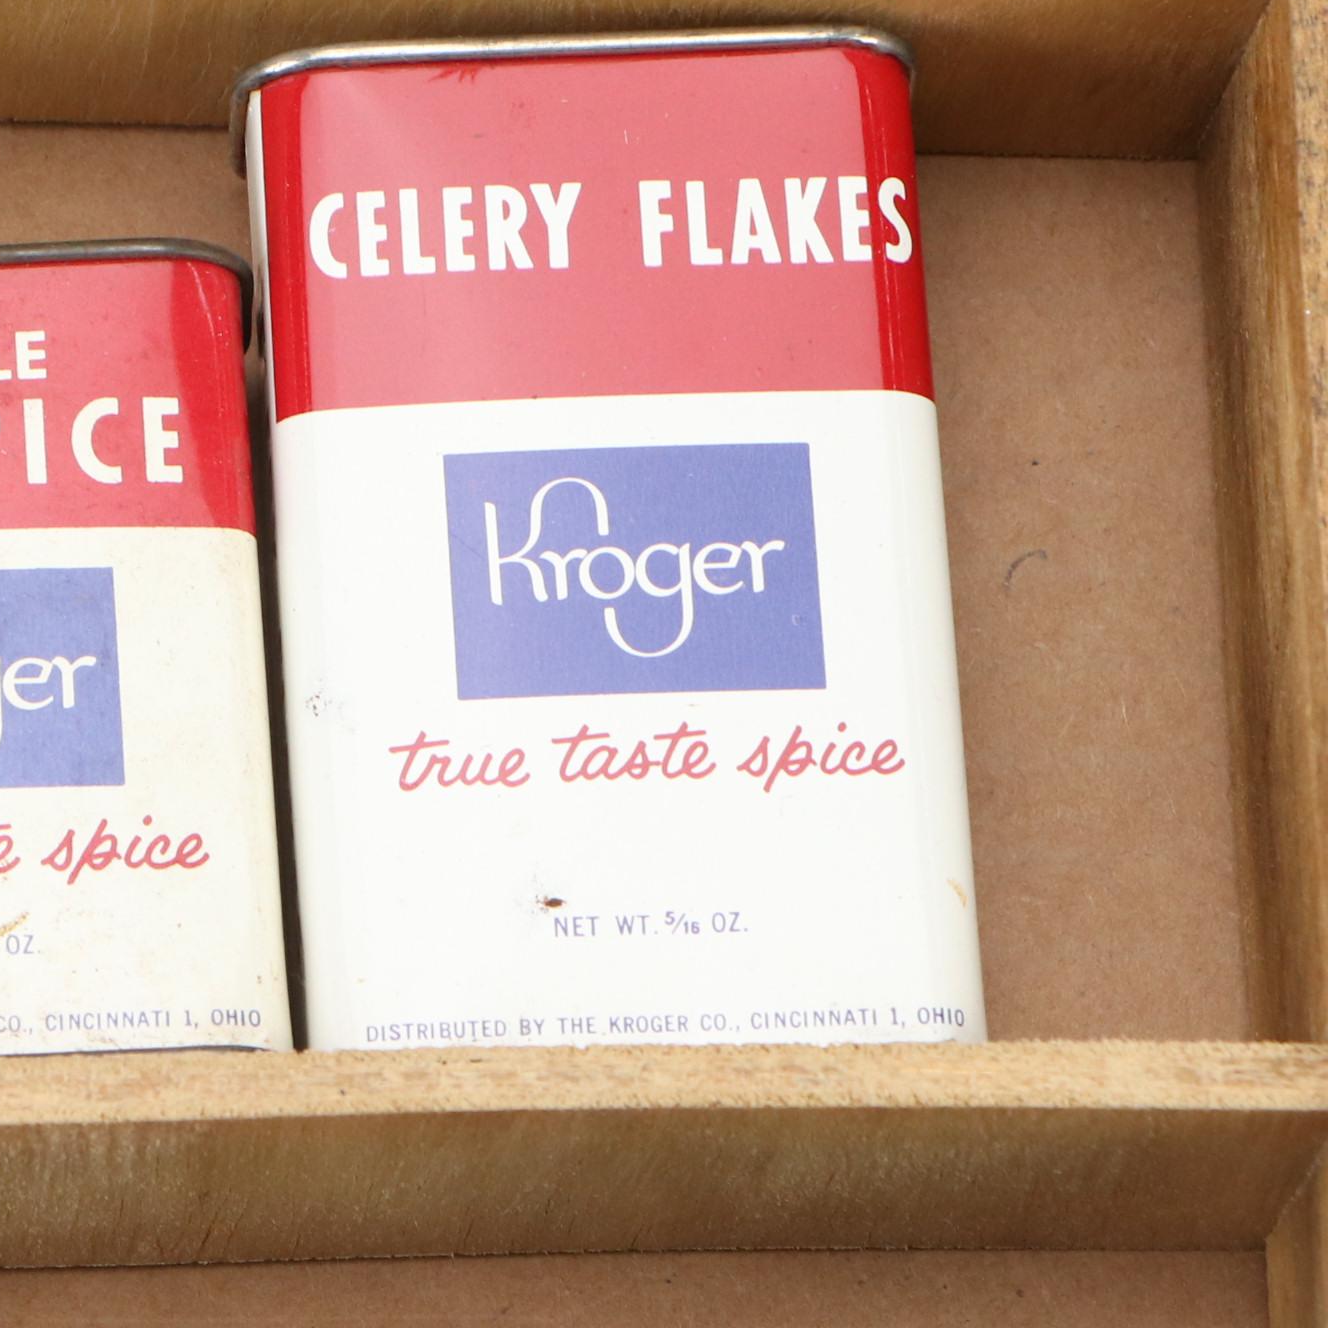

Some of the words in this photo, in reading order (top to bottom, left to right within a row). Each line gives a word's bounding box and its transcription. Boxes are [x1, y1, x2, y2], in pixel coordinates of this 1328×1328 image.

[308, 182, 582, 280] CELERY
[638, 176, 914, 267] FLAKES
[484, 476, 786, 658] Kroger
[389, 731, 530, 792] true
[551, 723, 717, 784] taste
[737, 722, 907, 793] spice
[40, 815, 211, 887] spice
[5, 933, 41, 956] OZ.
[553, 916, 600, 938] NET
[615, 914, 658, 935] WT.
[711, 911, 749, 934] OZ.
[45, 1010, 171, 1032] CINCINNATI
[183, 1010, 199, 1030] 1,
[210, 1008, 262, 1029] OHIO
[366, 1019, 508, 1043] DISTRIBUTED
[519, 1017, 545, 1037] BY
[558, 1015, 597, 1036] THE
[609, 1014, 689, 1035] KROGER
[699, 1013, 741, 1034] CO.,
[750, 1008, 878, 1030] CINCINNATI
[890, 1007, 907, 1028] 1,
[917, 1006, 965, 1028] OHIO
